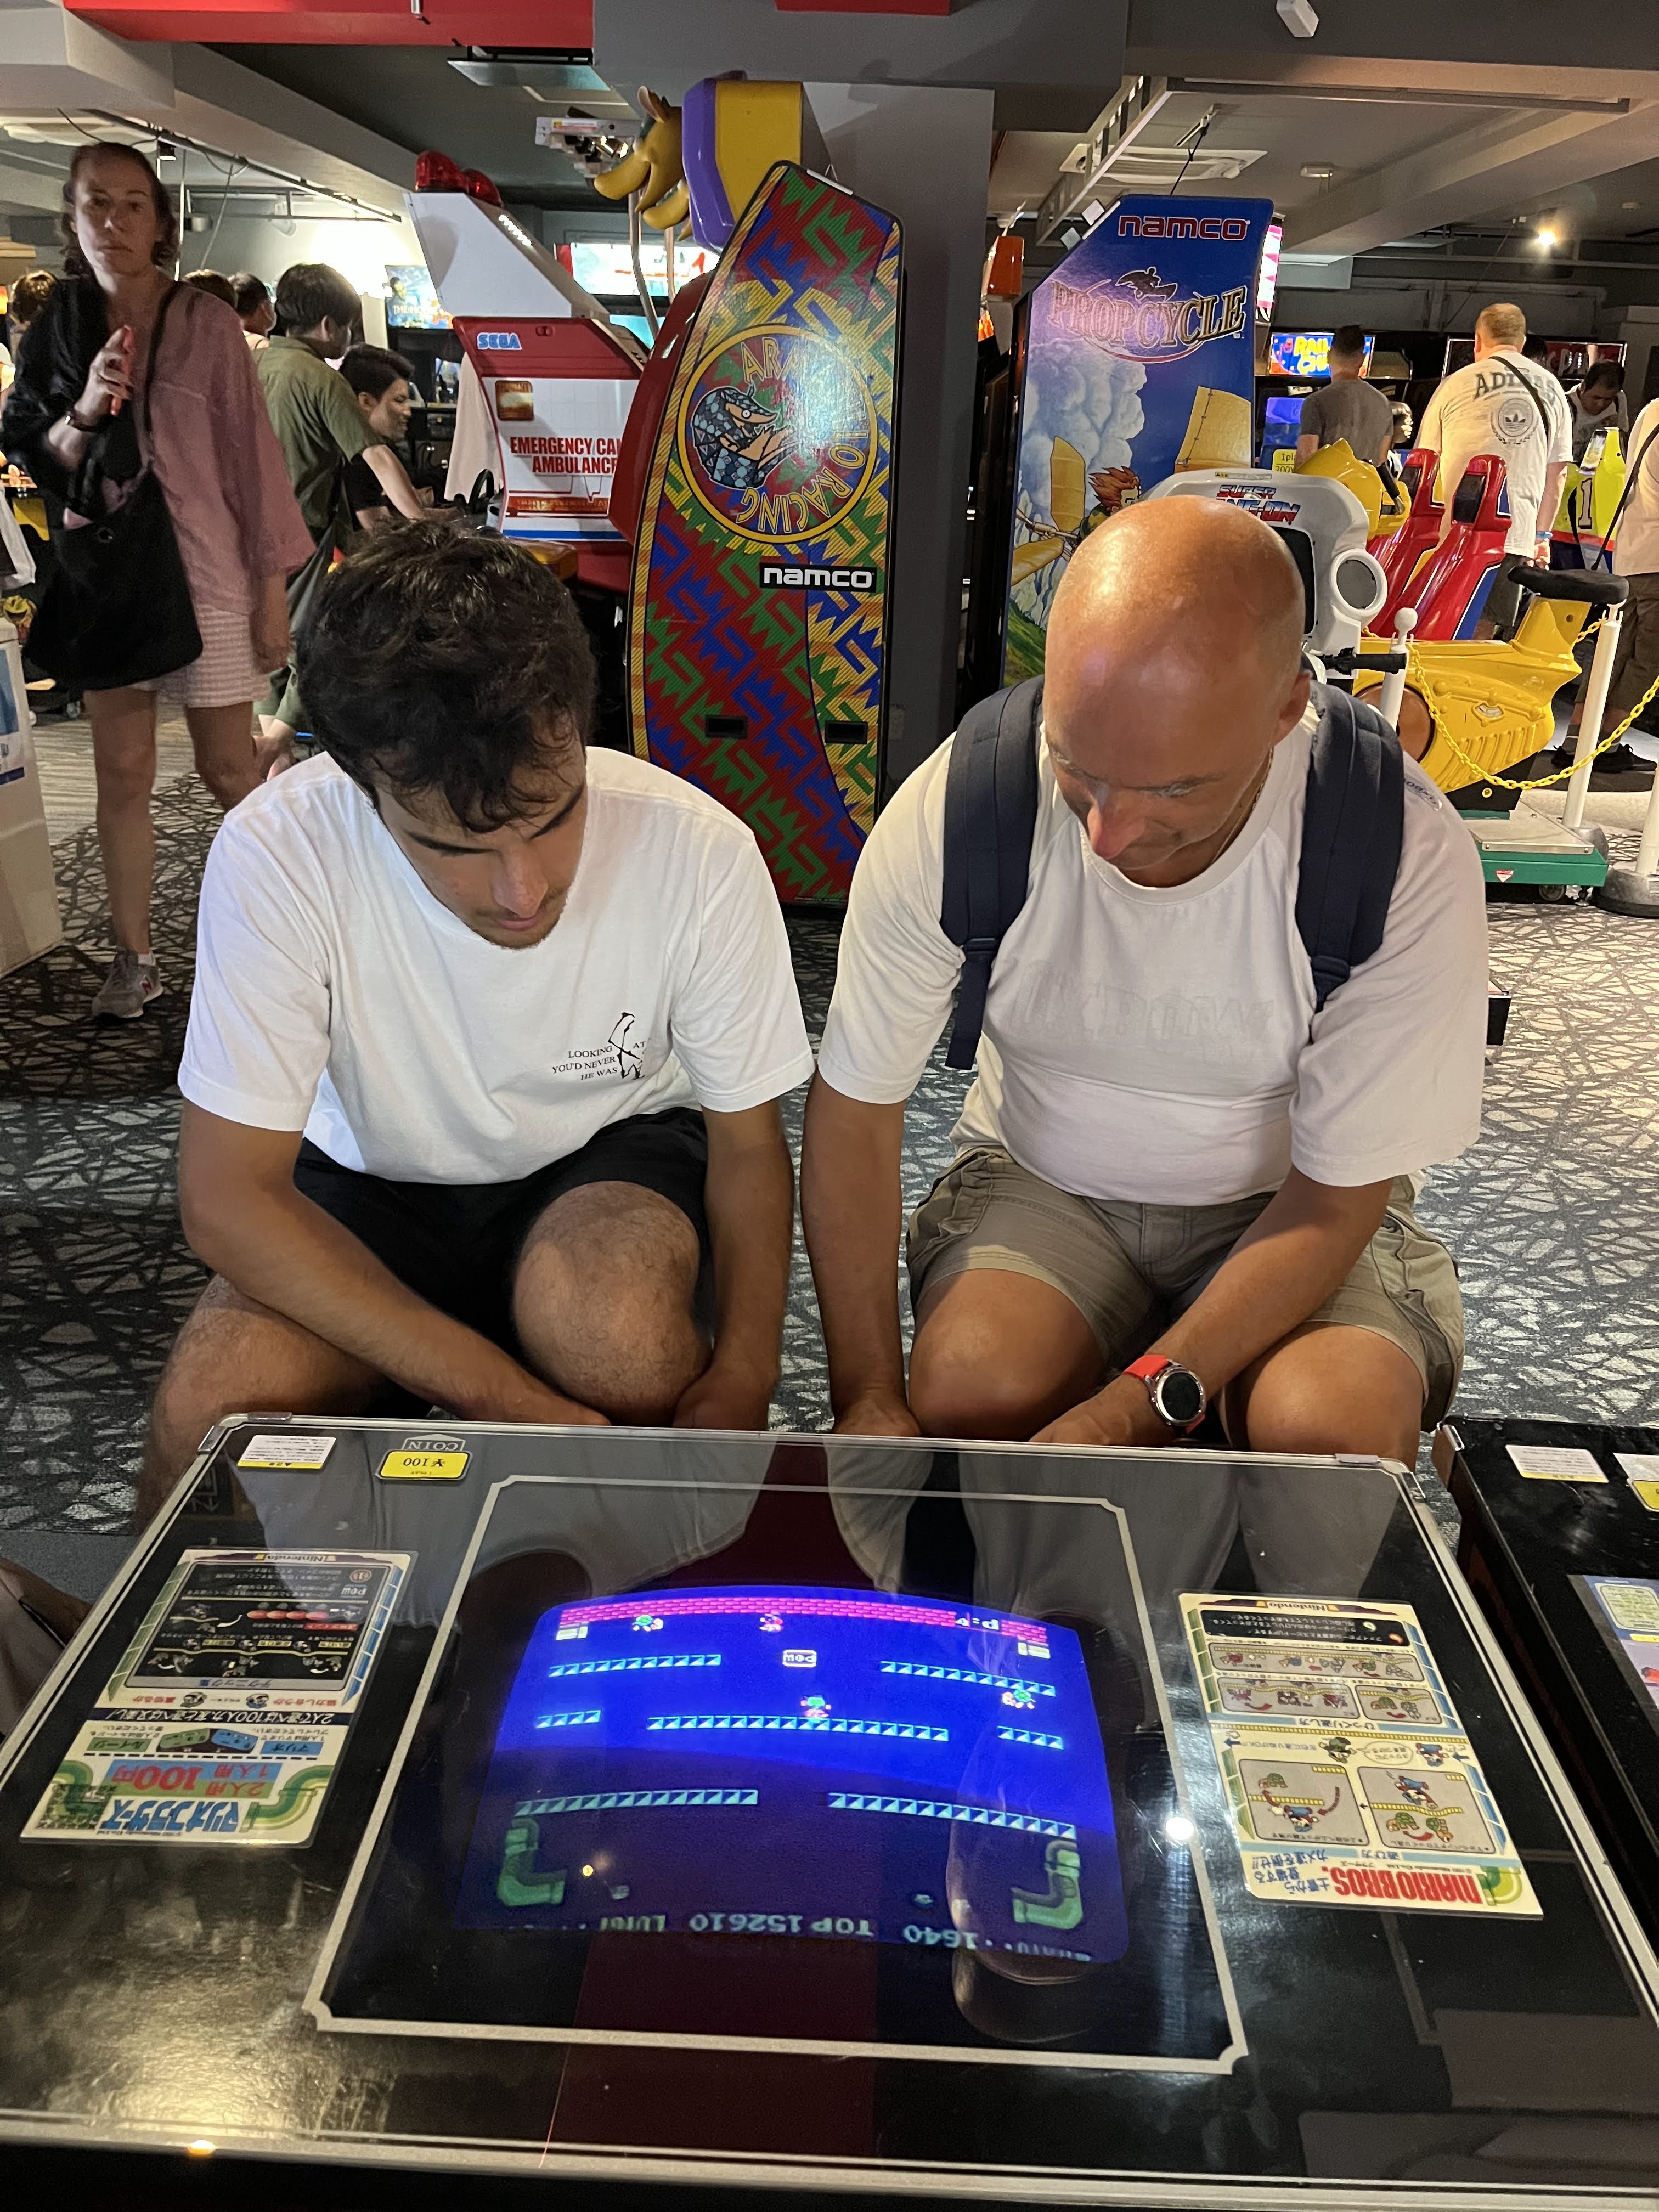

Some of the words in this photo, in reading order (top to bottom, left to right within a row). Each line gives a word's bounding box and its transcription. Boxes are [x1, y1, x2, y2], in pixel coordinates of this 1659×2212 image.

[1118, 215, 1248, 240] namco
[477, 333, 521, 350] SEGA
[510, 437, 593, 455] EMERGENCY
[1282, 453, 1295, 462] 1pl
[1216, 484, 1277, 500] SUPER
[736, 468, 854, 534] RACING
[764, 568, 872, 589] namco
[568, 1046, 613, 1058] LOOKING
[552, 1063, 582, 1074] YOU'D
[584, 1057, 616, 1069] NEVER
[597, 1067, 618, 1076] WAS
[407, 1441, 458, 1451] COIN
[1267, 1601, 1327, 1611] Nintendo
[272, 1743, 311, 1753] マリオ
[689, 1914, 803, 1933] 152610
[811, 1917, 874, 1936] TOP
